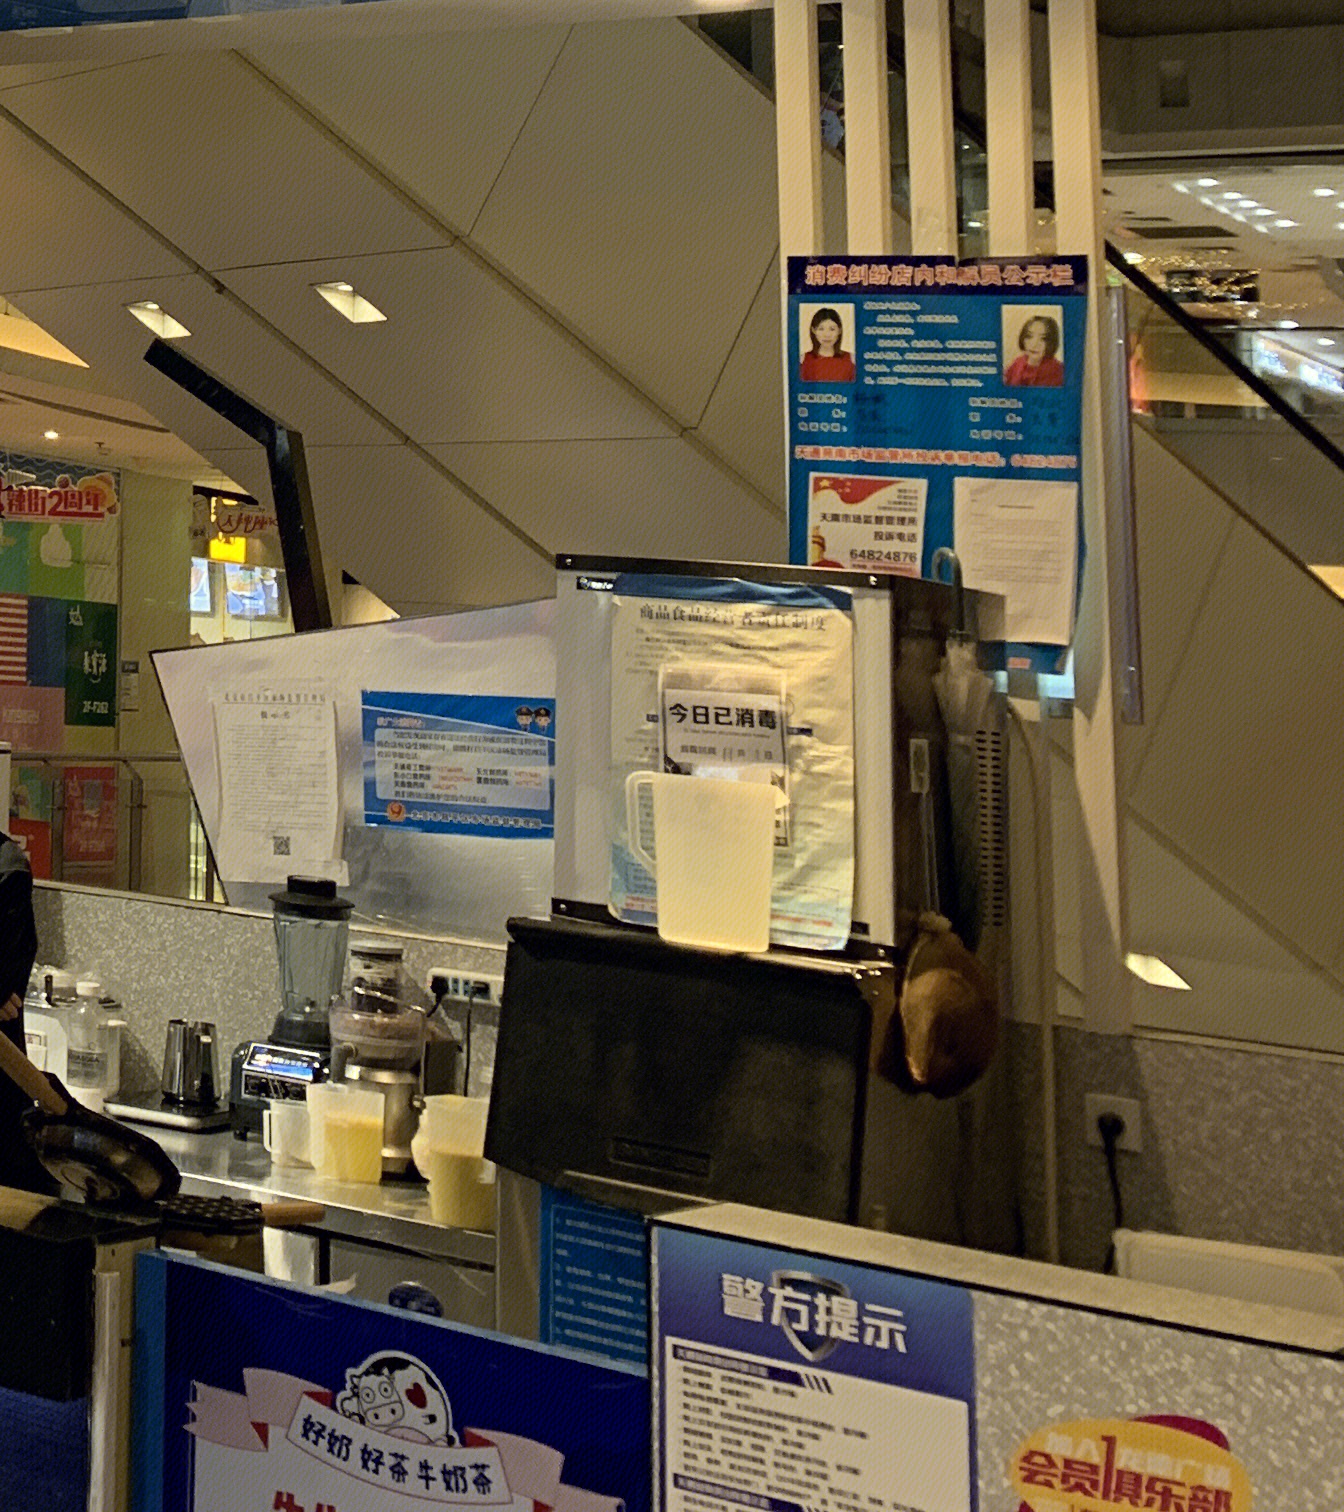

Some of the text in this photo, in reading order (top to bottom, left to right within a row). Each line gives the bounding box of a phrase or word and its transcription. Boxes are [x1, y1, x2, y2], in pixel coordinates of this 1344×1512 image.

[819, 512, 918, 528] 天南市场监督管理所
[874, 529, 918, 545] 投诉电话
[849, 548, 918, 565] 64824876
[669, 702, 778, 730] 今日已消毒
[719, 1272, 909, 1354] 警方提示
